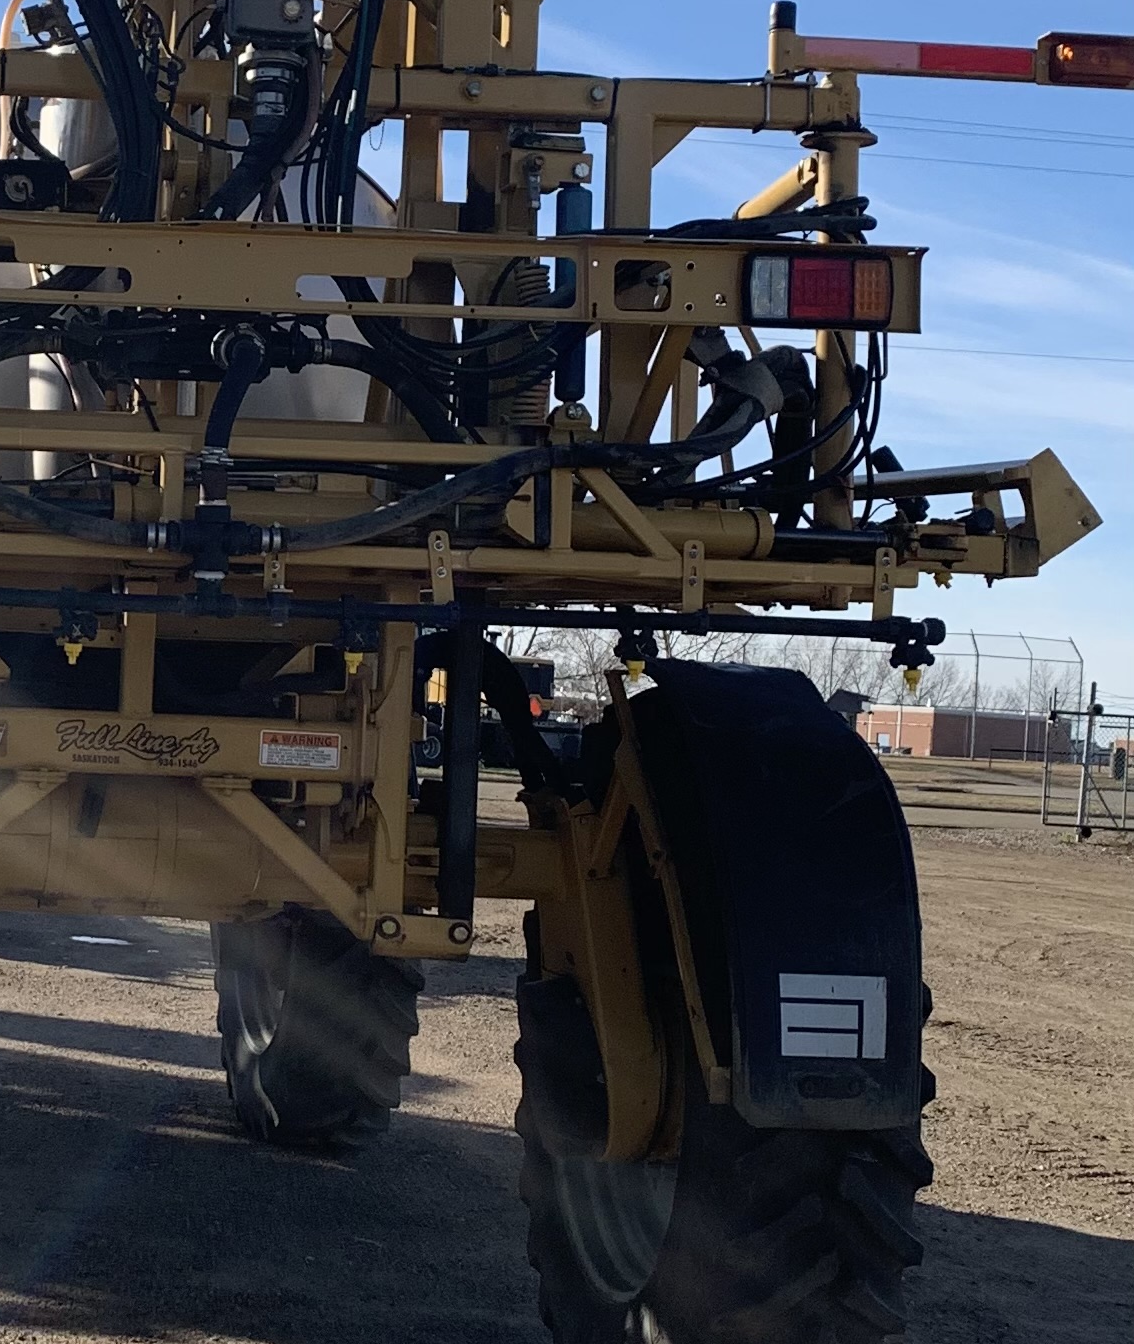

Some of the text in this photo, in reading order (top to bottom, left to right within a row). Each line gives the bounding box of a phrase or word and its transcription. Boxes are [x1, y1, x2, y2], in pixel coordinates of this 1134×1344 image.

[56, 720, 219, 764] Full Line Ag
[280, 735, 332, 746] WARNING
[72, 755, 120, 765] SASKATOON
